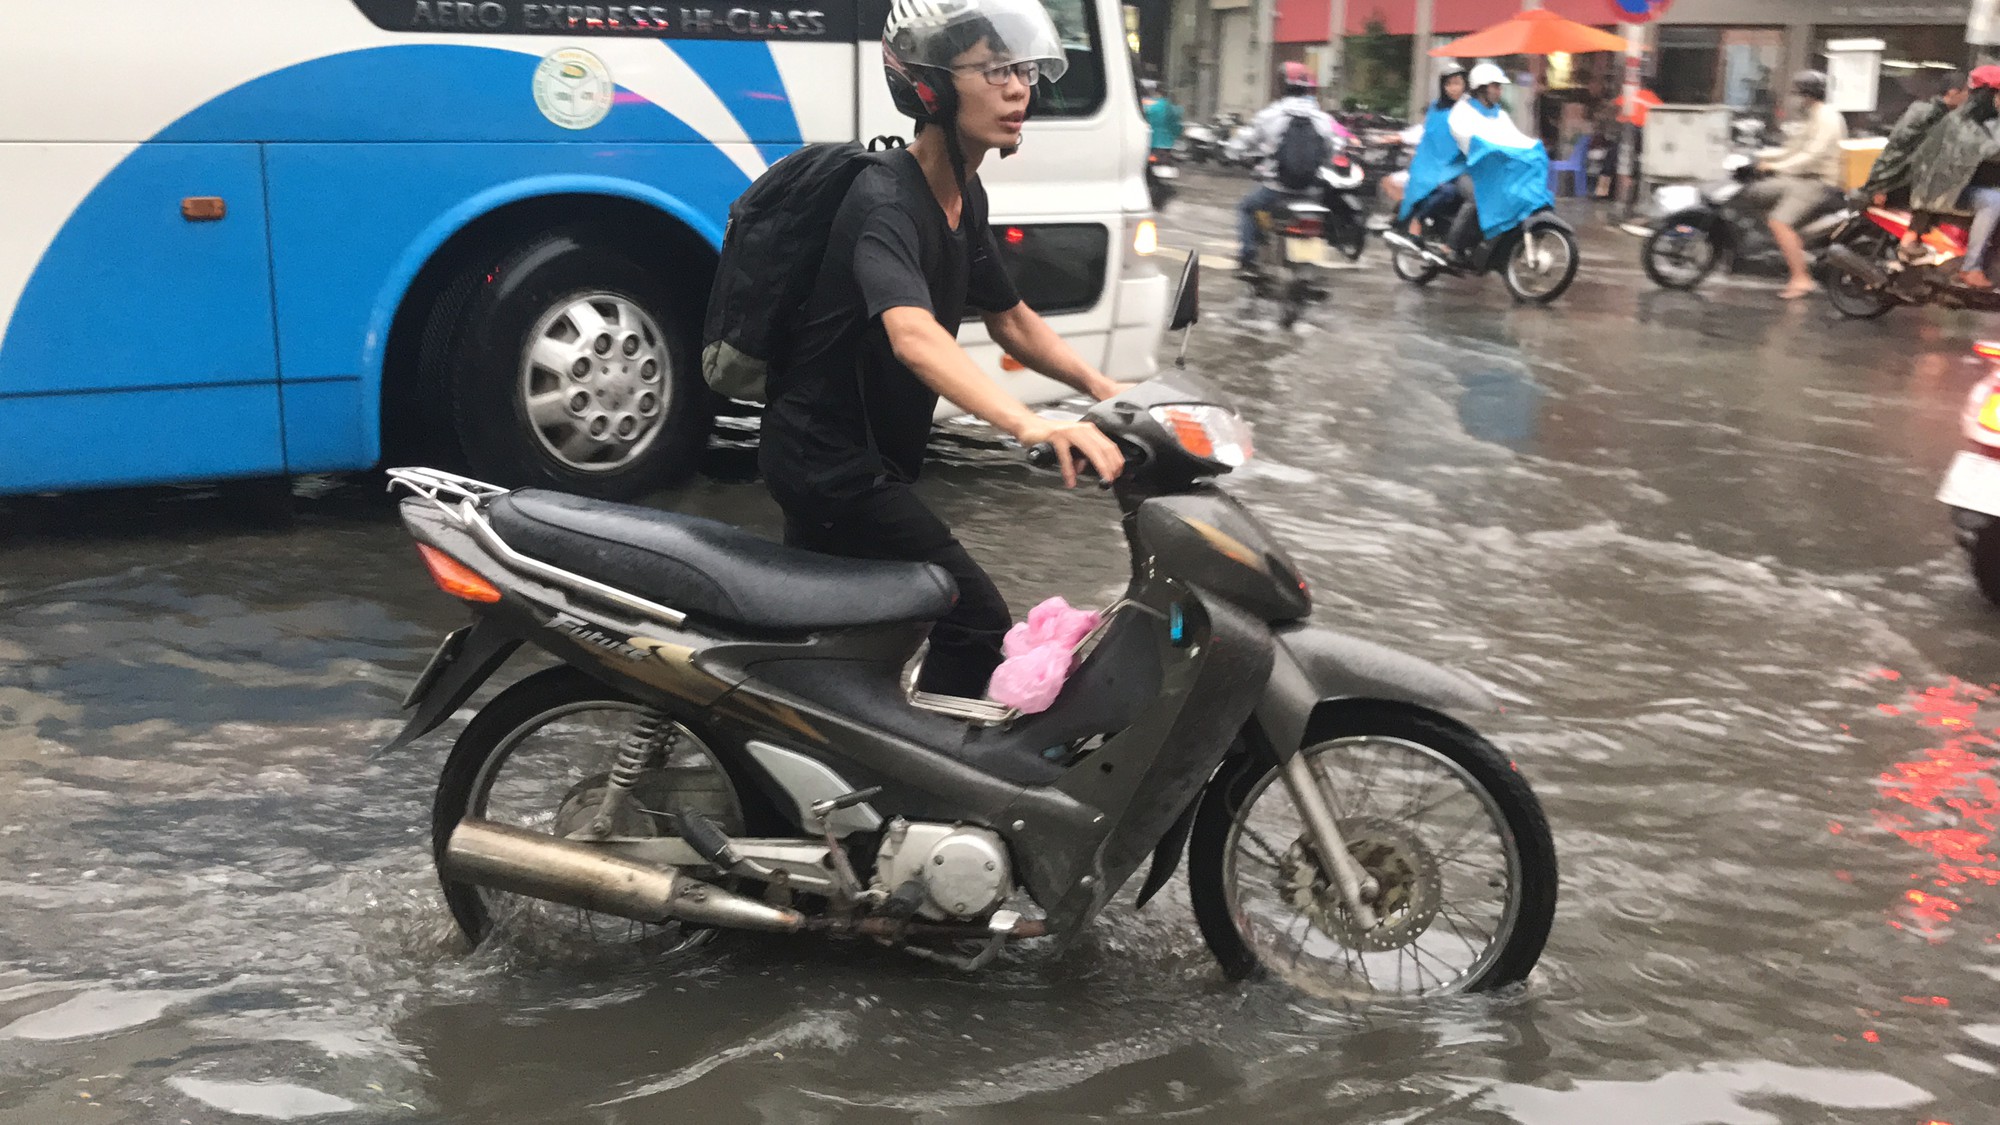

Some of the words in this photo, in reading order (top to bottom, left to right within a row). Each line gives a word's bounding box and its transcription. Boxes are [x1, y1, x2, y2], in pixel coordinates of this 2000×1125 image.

[412, 0, 507, 28] AERO
[523, 4, 669, 31] EXPRESS
[680, 7, 827, 35] HI-CLASS
